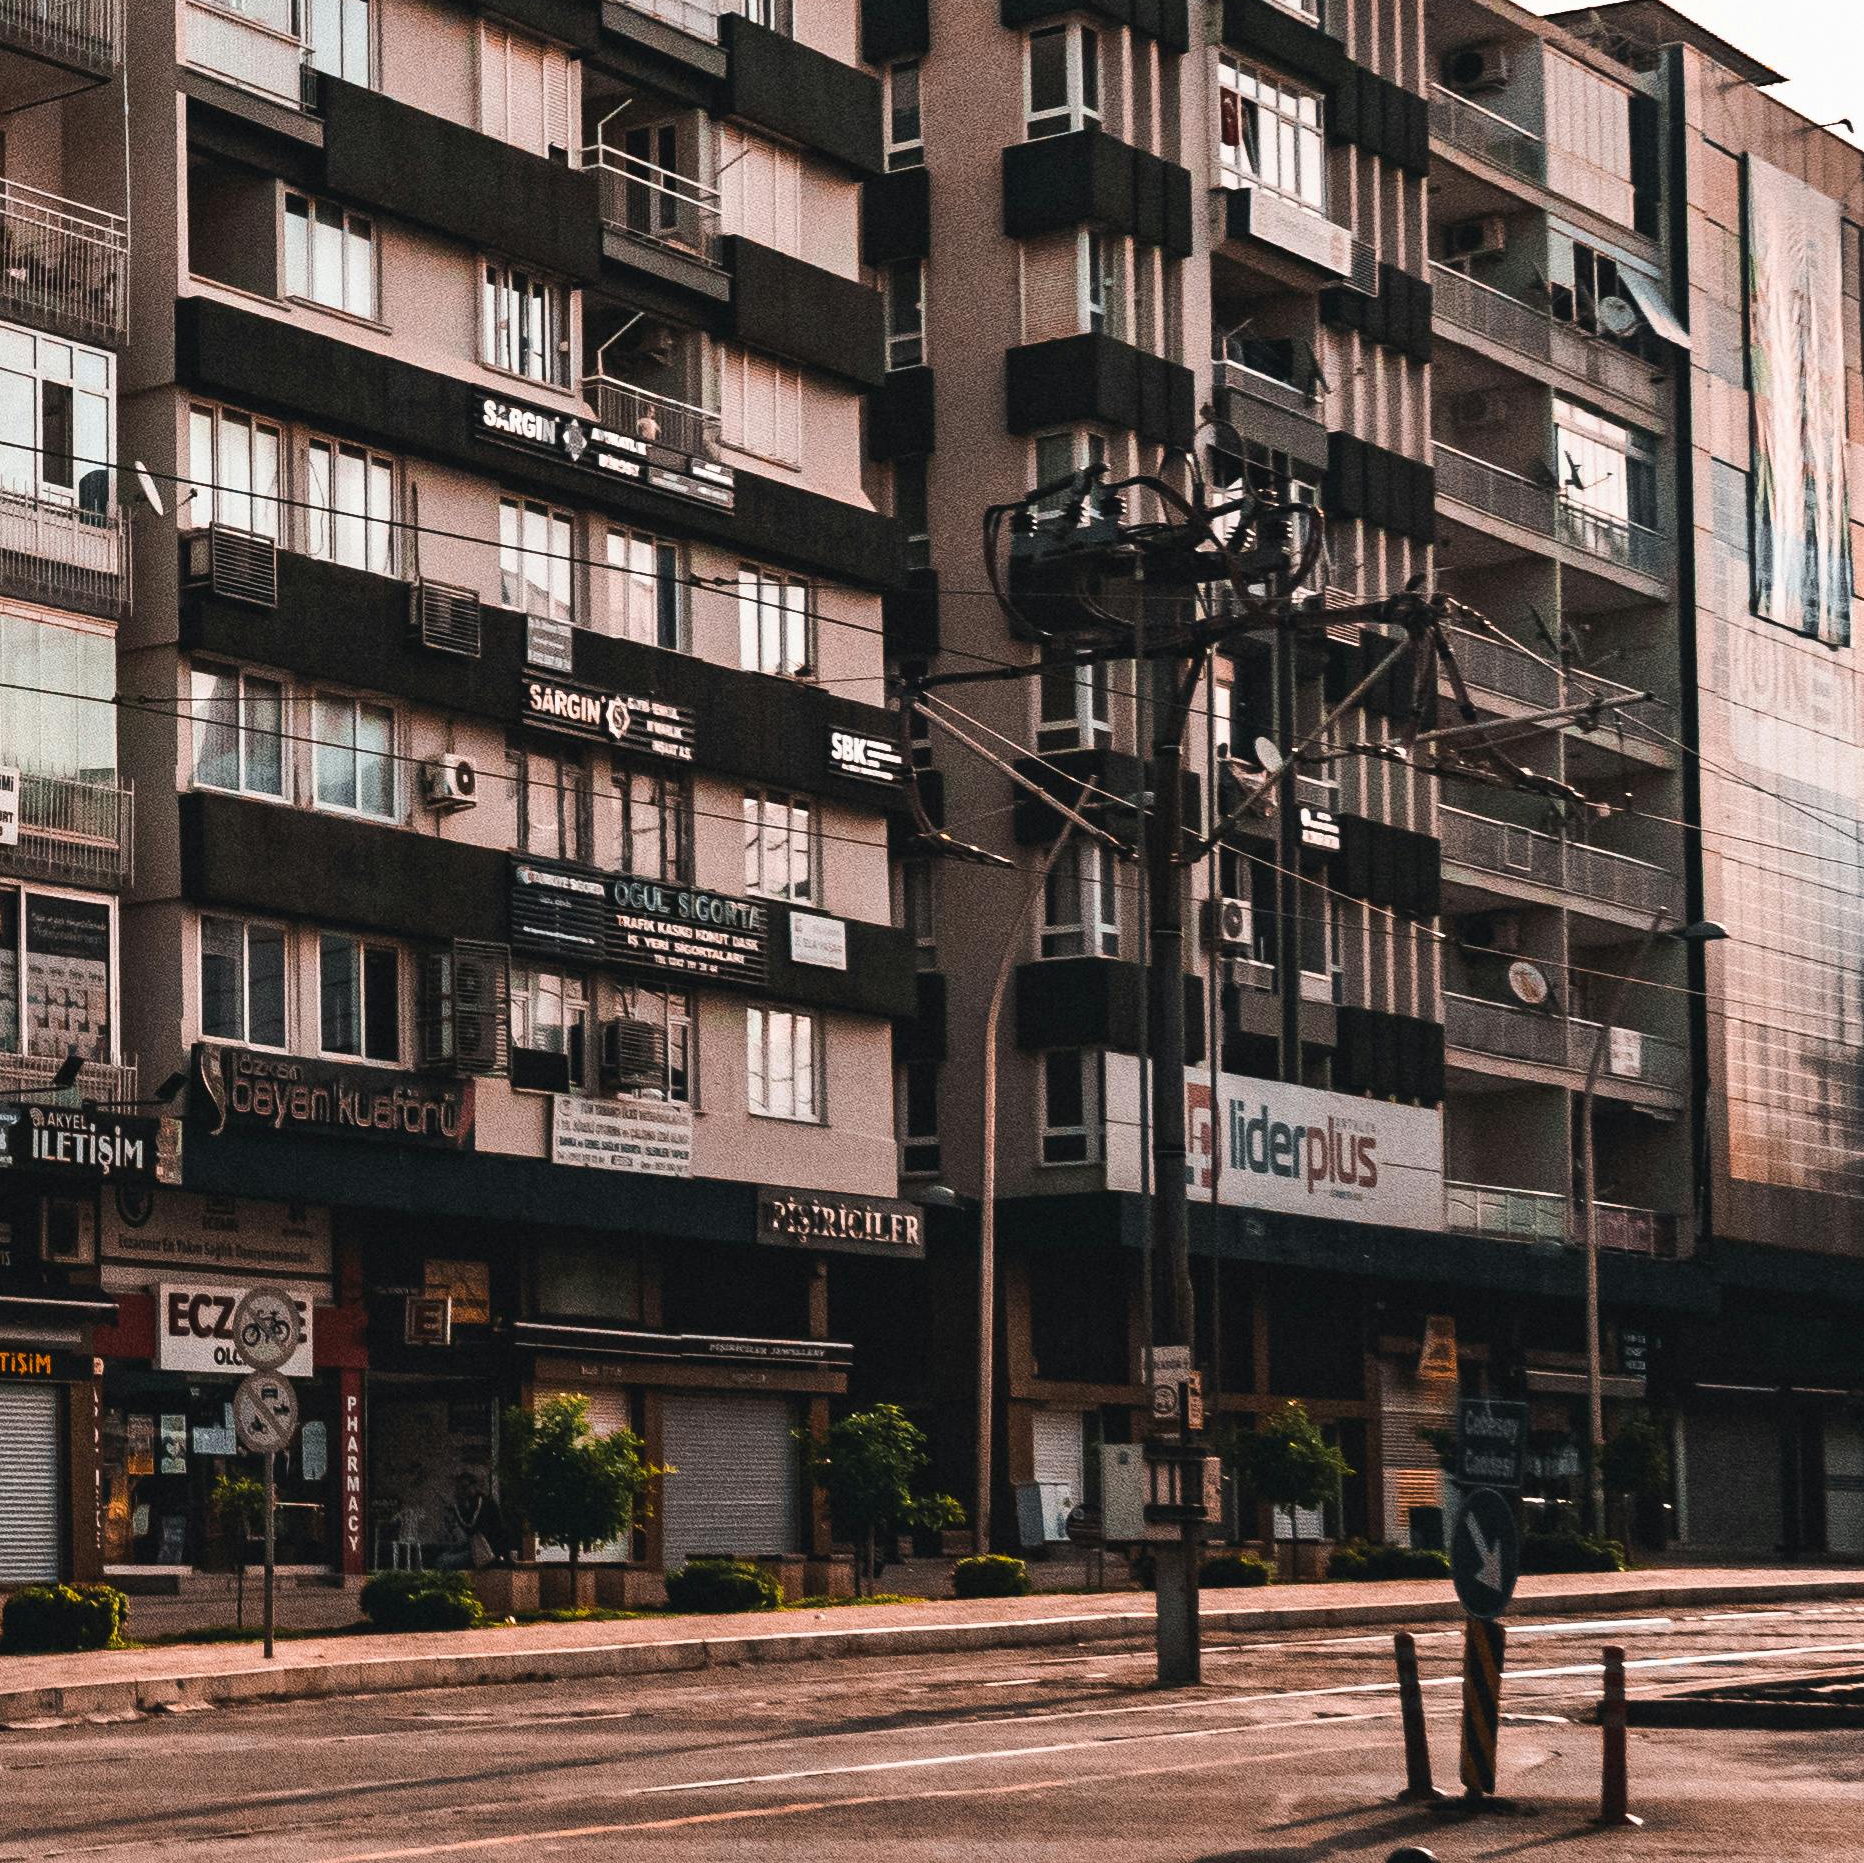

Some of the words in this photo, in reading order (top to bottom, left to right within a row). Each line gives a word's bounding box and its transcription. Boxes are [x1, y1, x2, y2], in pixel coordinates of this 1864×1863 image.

[831, 732, 867, 765] SBK
[47, 1112, 88, 1130] AKYEL
[168, 1292, 307, 1345] ECZE
[345, 1395, 361, 1553] PHARMACY
